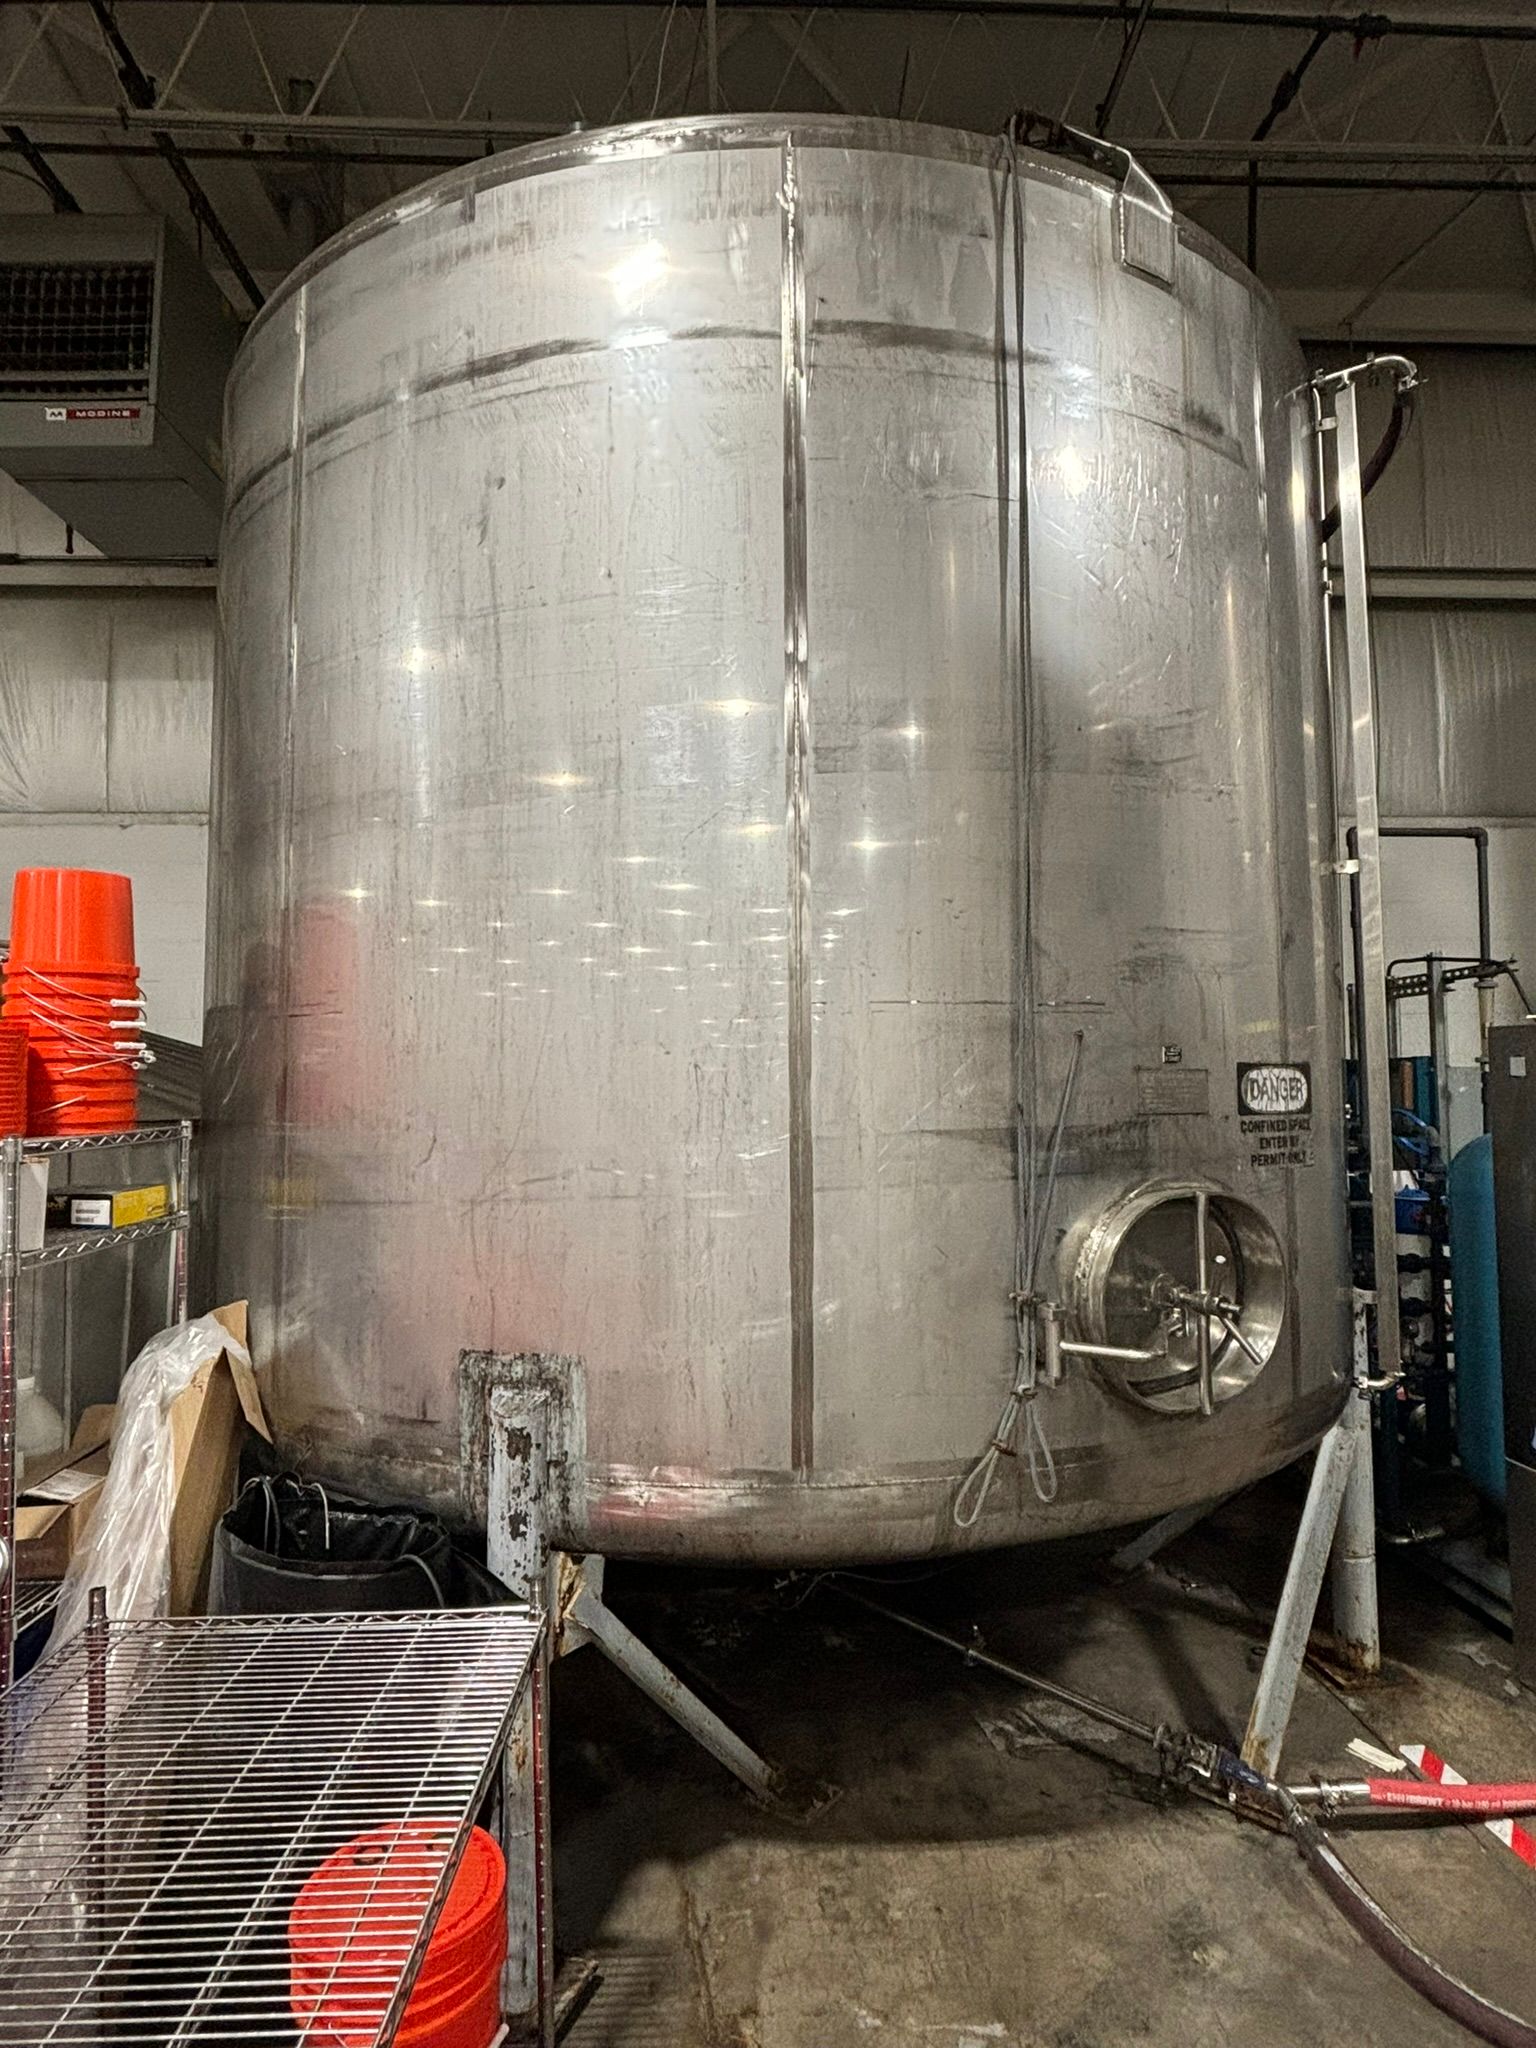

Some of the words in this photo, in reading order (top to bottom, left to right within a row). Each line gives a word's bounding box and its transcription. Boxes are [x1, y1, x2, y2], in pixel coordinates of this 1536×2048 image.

[75, 409, 131, 418] MODINE
[1248, 1077, 1304, 1101] DANGER
[1240, 1119, 1287, 1134] CONFINED
[1260, 1136, 1288, 1150] ENTER
[1250, 1152, 1286, 1167] PERMIT
